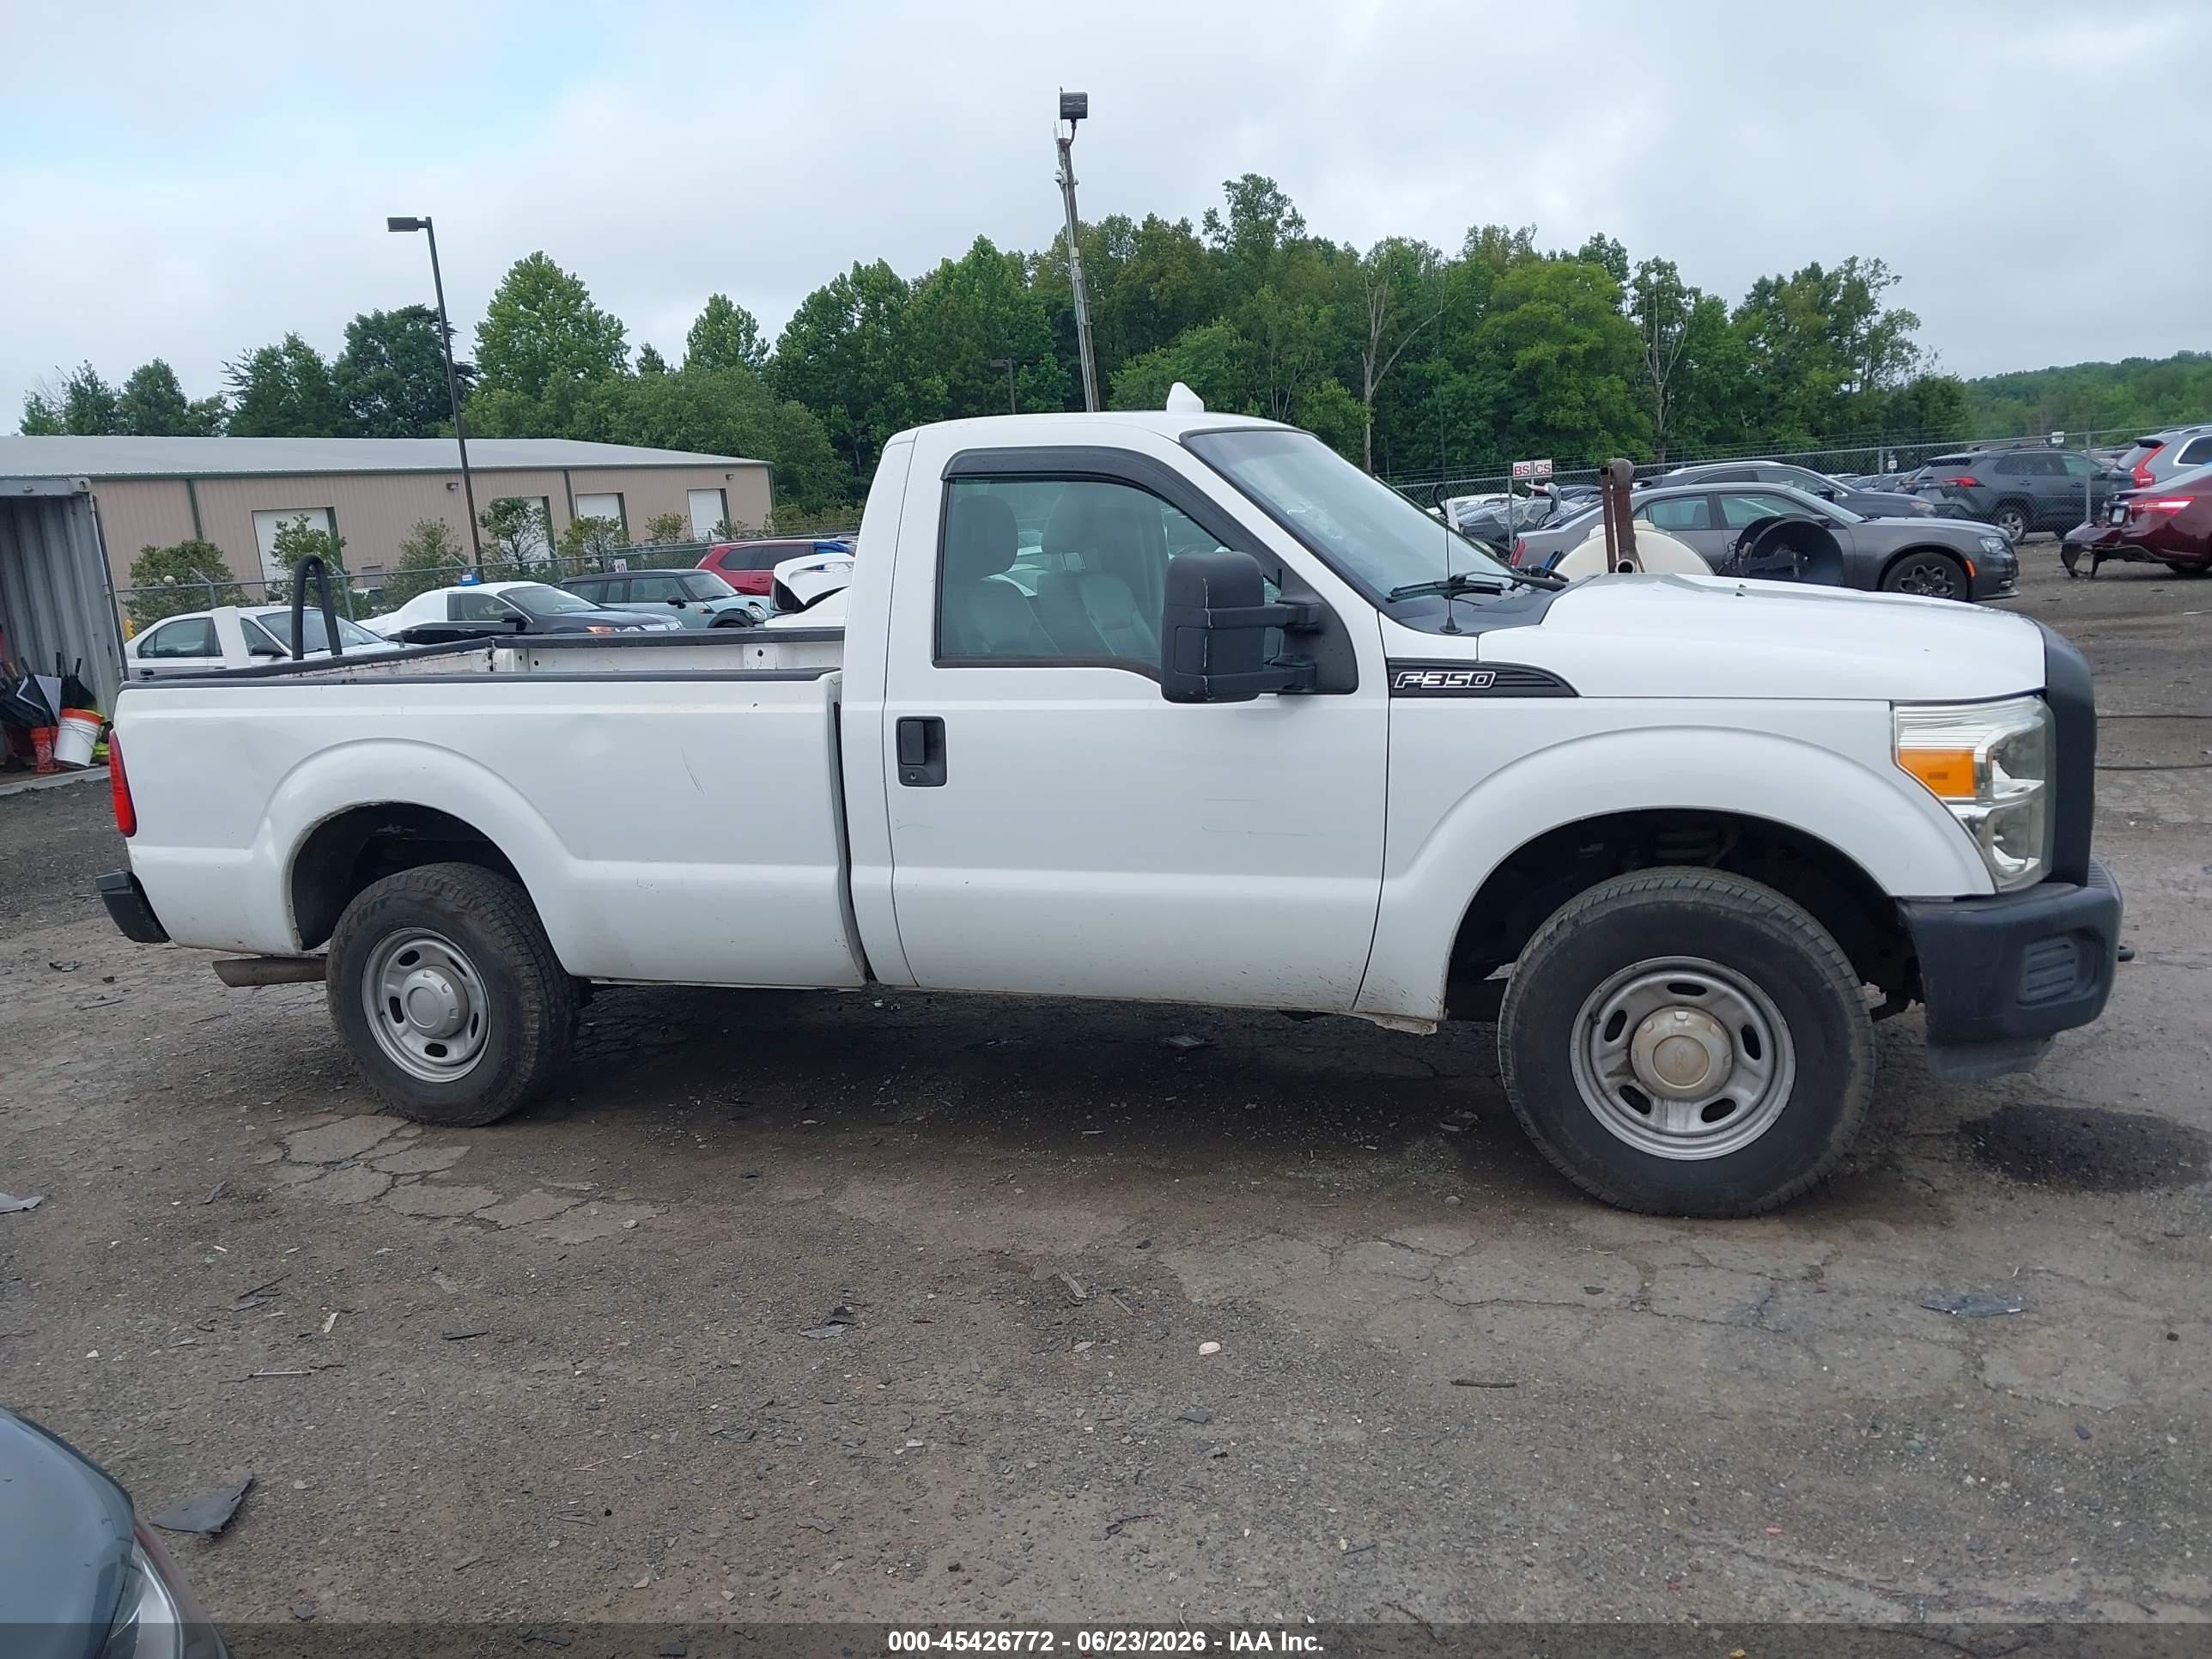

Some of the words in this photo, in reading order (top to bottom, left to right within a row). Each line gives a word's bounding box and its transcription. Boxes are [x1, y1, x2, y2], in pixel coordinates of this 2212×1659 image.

[1514, 465, 1529, 476] BS
[1535, 464, 1551, 474] CS
[1394, 672, 1496, 689] F-350
